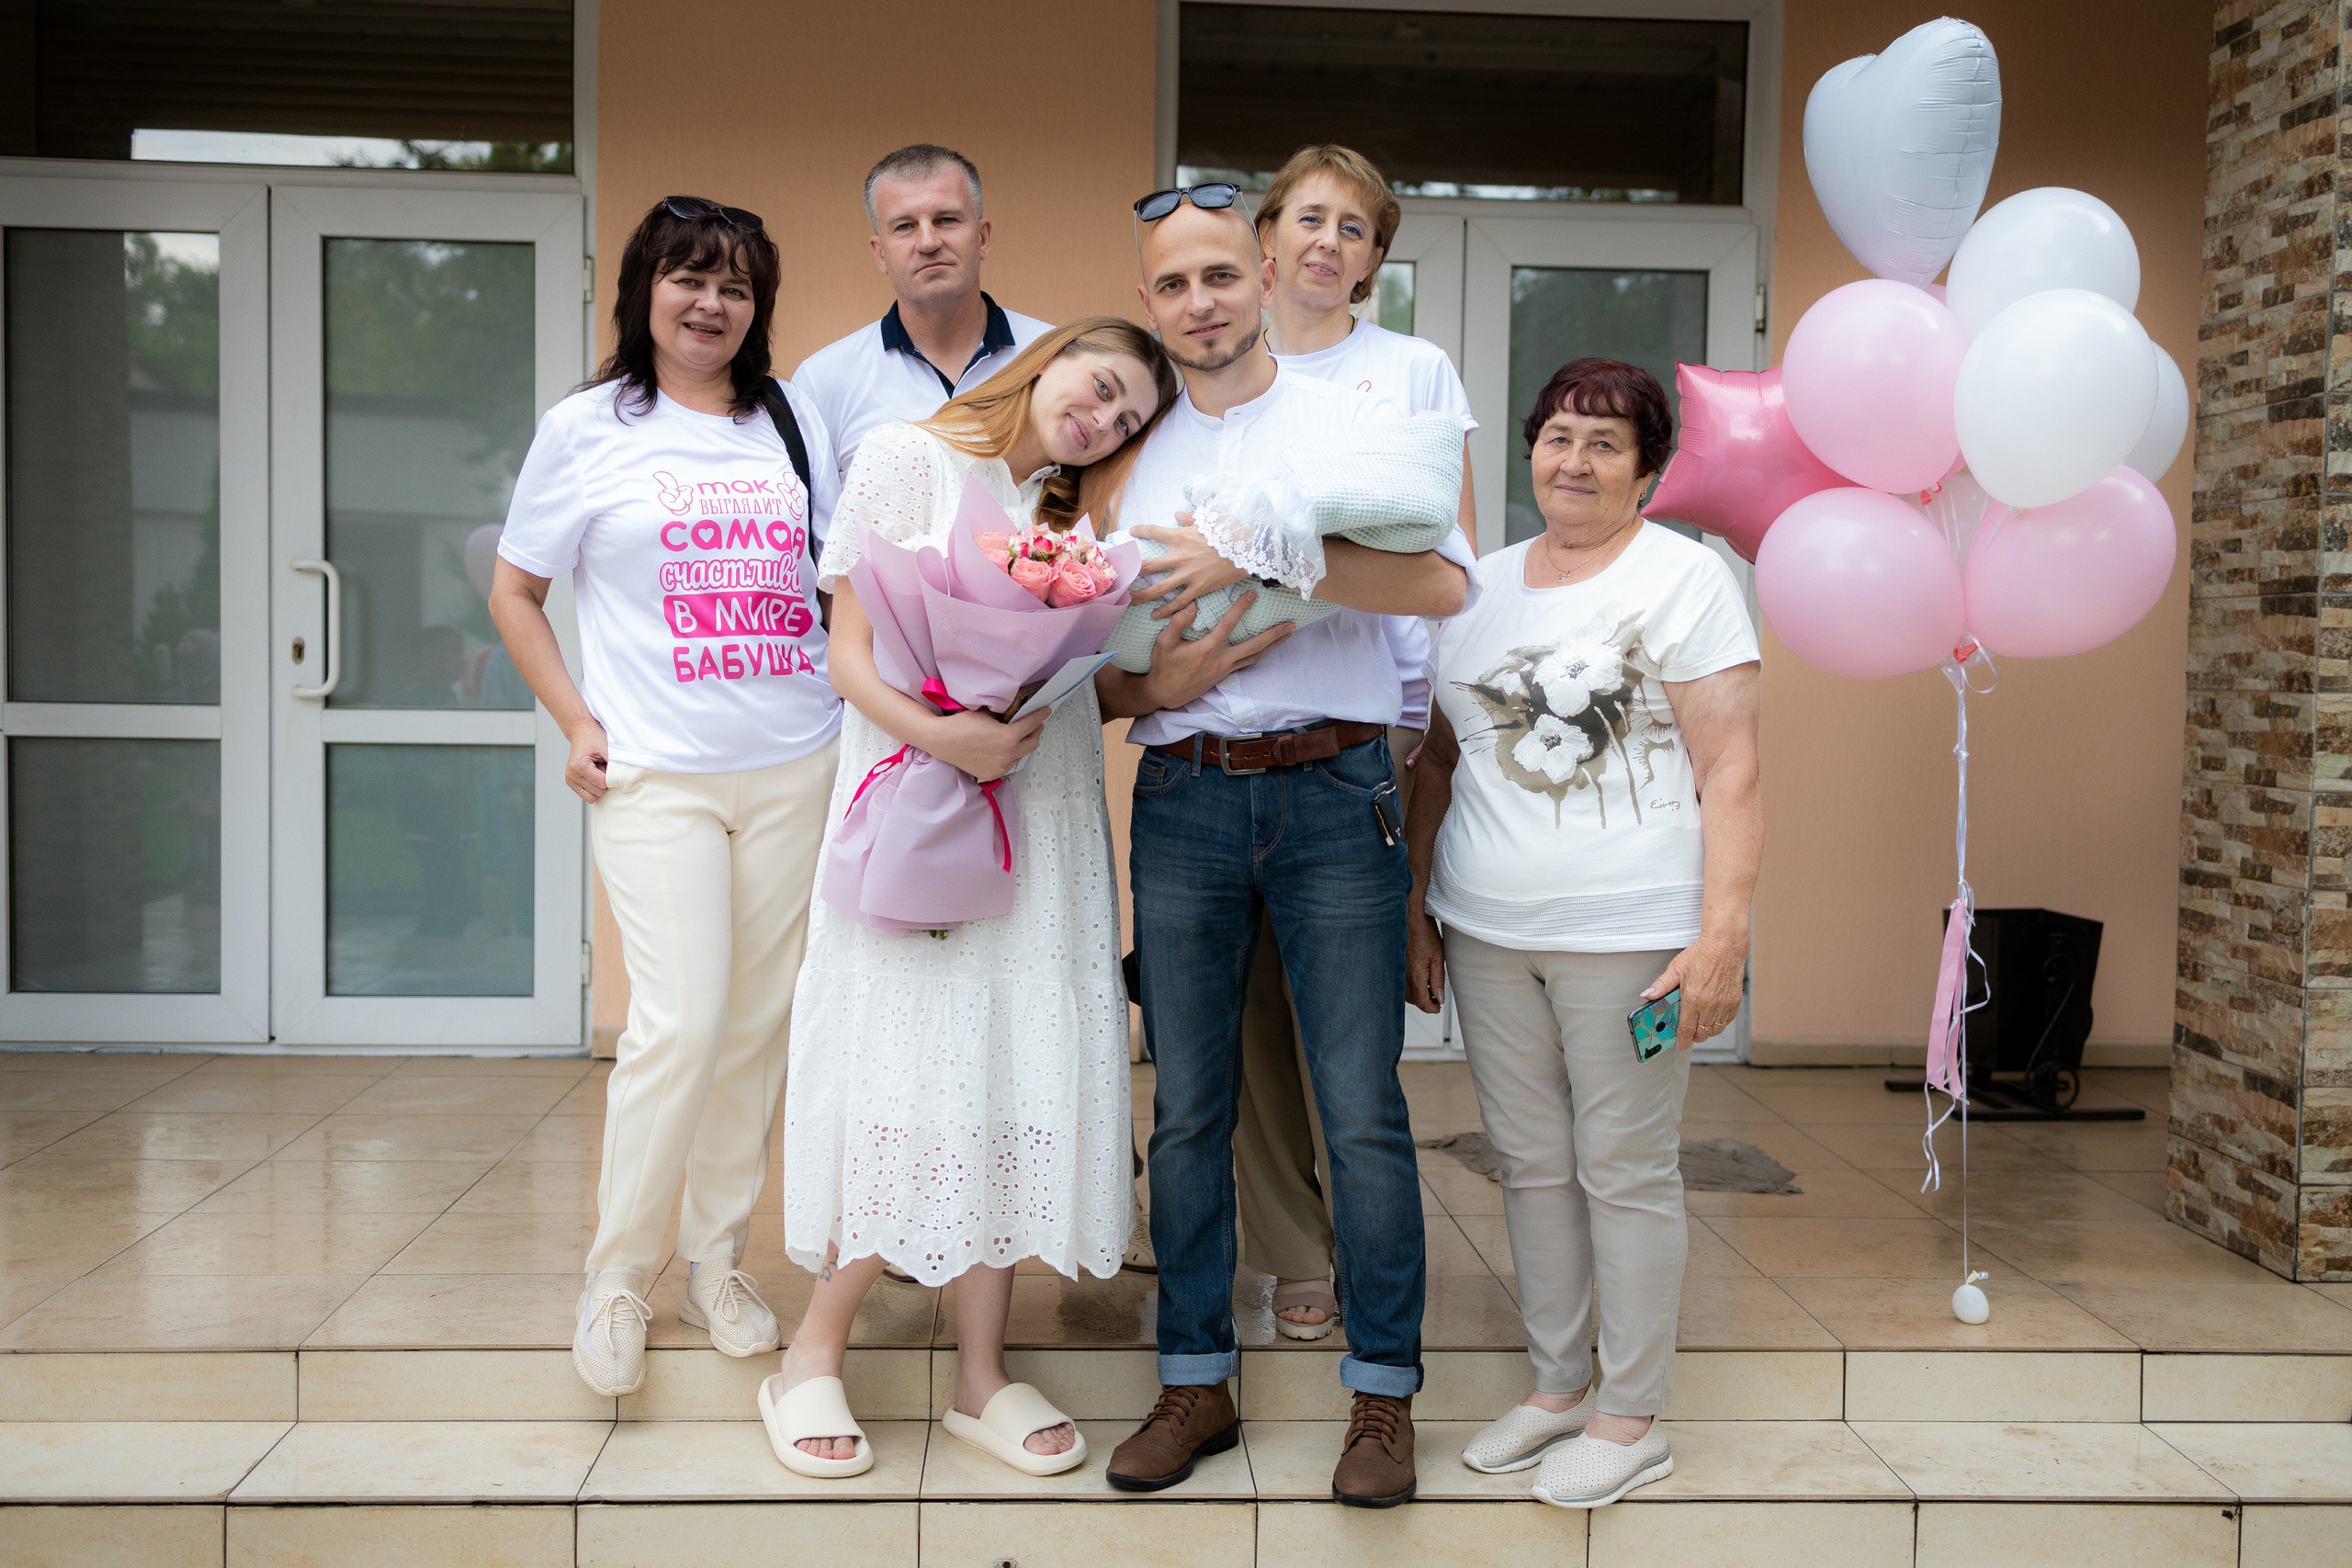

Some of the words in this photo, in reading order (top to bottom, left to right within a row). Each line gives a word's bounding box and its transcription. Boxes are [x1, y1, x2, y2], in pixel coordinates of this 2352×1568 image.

[697, 479, 775, 495] так
[699, 498, 782, 515] ВЫГЛЯДИТ
[673, 600, 697, 634] В
[716, 596, 808, 632] МИРЕ
